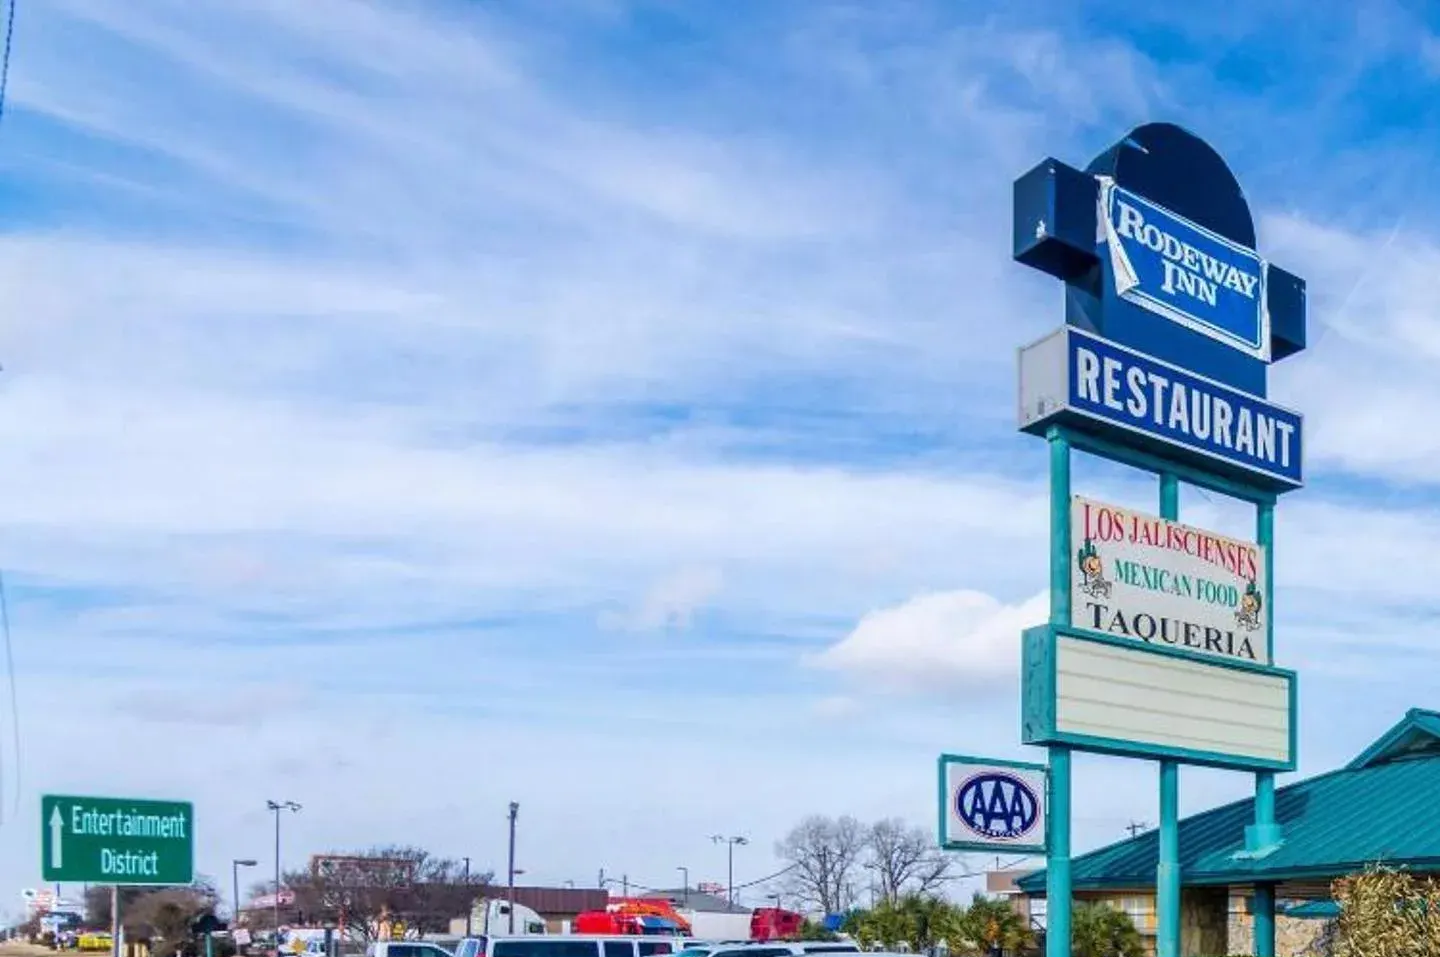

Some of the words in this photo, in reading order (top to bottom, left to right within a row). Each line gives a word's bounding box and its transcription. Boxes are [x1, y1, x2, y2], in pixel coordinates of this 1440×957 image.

[1117, 199, 1258, 299] RODEWAY
[1161, 261, 1218, 306] INN
[1077, 348, 1294, 468] RESTAURANT
[1084, 504, 1125, 542] LOS
[1129, 516, 1258, 583] JALISCIENSES
[1114, 558, 1192, 598] MEXICAN
[1196, 578, 1239, 608] FOOD
[1086, 602, 1257, 660] TAQUERIA
[71, 805, 187, 839] Entertainment
[970, 778, 1027, 832] AAA
[101, 848, 159, 876] District
